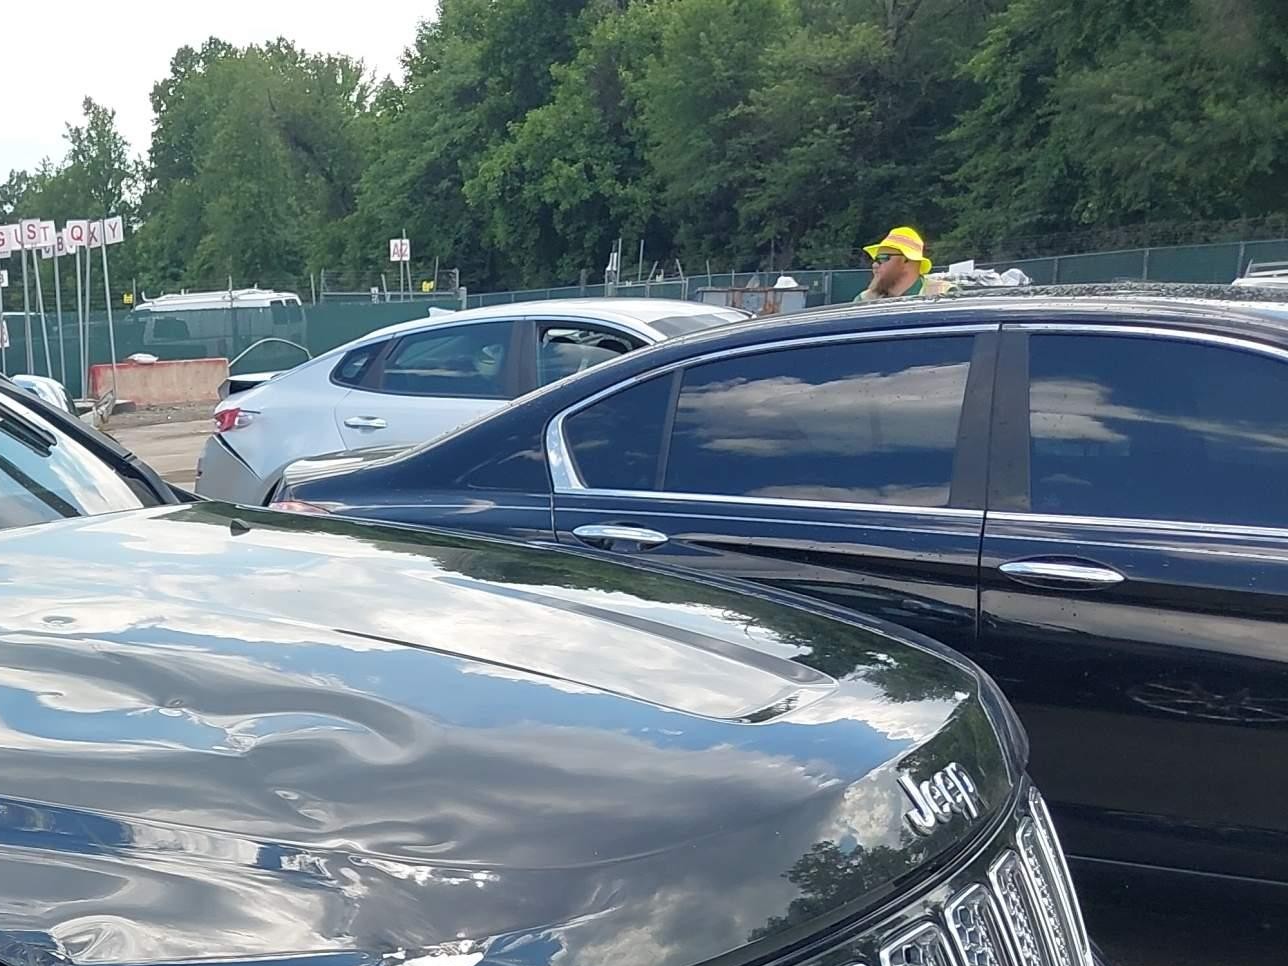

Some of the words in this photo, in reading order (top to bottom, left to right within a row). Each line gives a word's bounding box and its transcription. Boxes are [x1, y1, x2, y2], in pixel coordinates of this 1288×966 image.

[27, 224, 37, 240] S
[40, 226, 49, 241] T
[71, 225, 83, 241] Q
[108, 221, 118, 239] Y
[896, 762, 979, 833] Jeep
